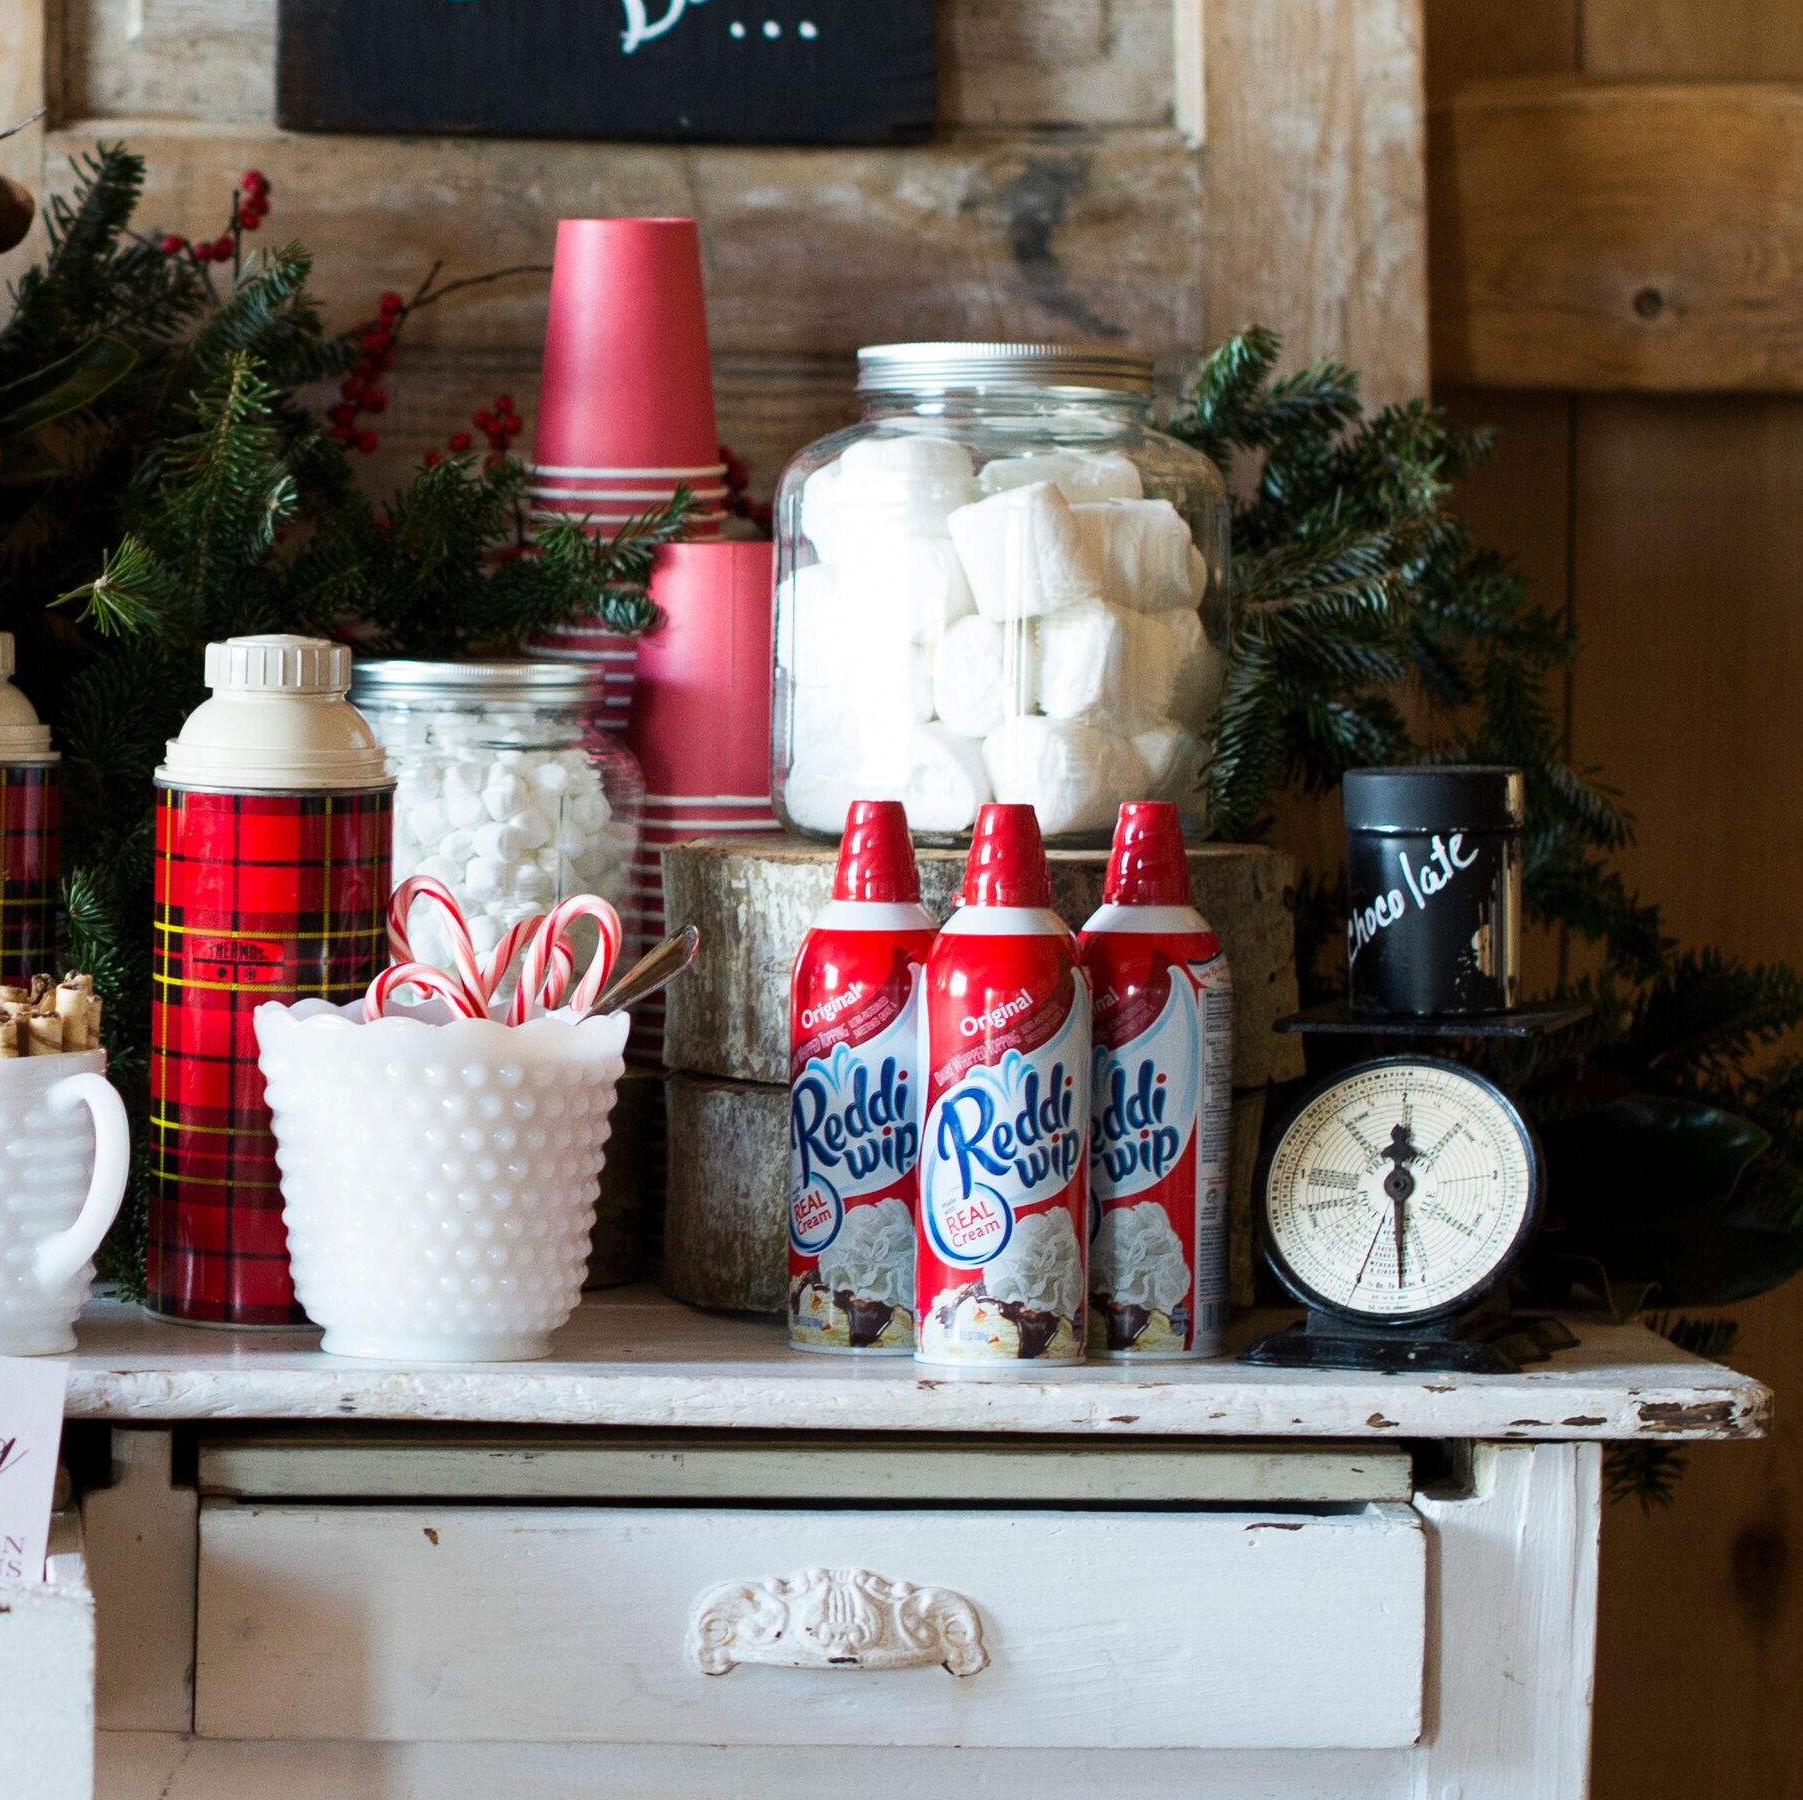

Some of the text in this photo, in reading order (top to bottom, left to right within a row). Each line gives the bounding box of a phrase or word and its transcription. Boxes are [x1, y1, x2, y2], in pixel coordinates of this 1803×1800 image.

[801, 982, 863, 1029] Original
[960, 988, 1034, 1036] Original
[1401, 1092, 1408, 1102] 2
[791, 1056, 908, 1189] Reddi
[937, 1062, 1073, 1200] Reddi
[843, 1122, 918, 1179] wip
[1014, 1129, 1080, 1188] wip
[1101, 1125, 1179, 1179] wip
[1300, 1168, 1305, 1179] 1
[1492, 1170, 1498, 1180] 3
[793, 1191, 828, 1222] REAL
[798, 1210, 832, 1236] Cream
[946, 1201, 995, 1234] REAL
[952, 1218, 1001, 1248] Cream
